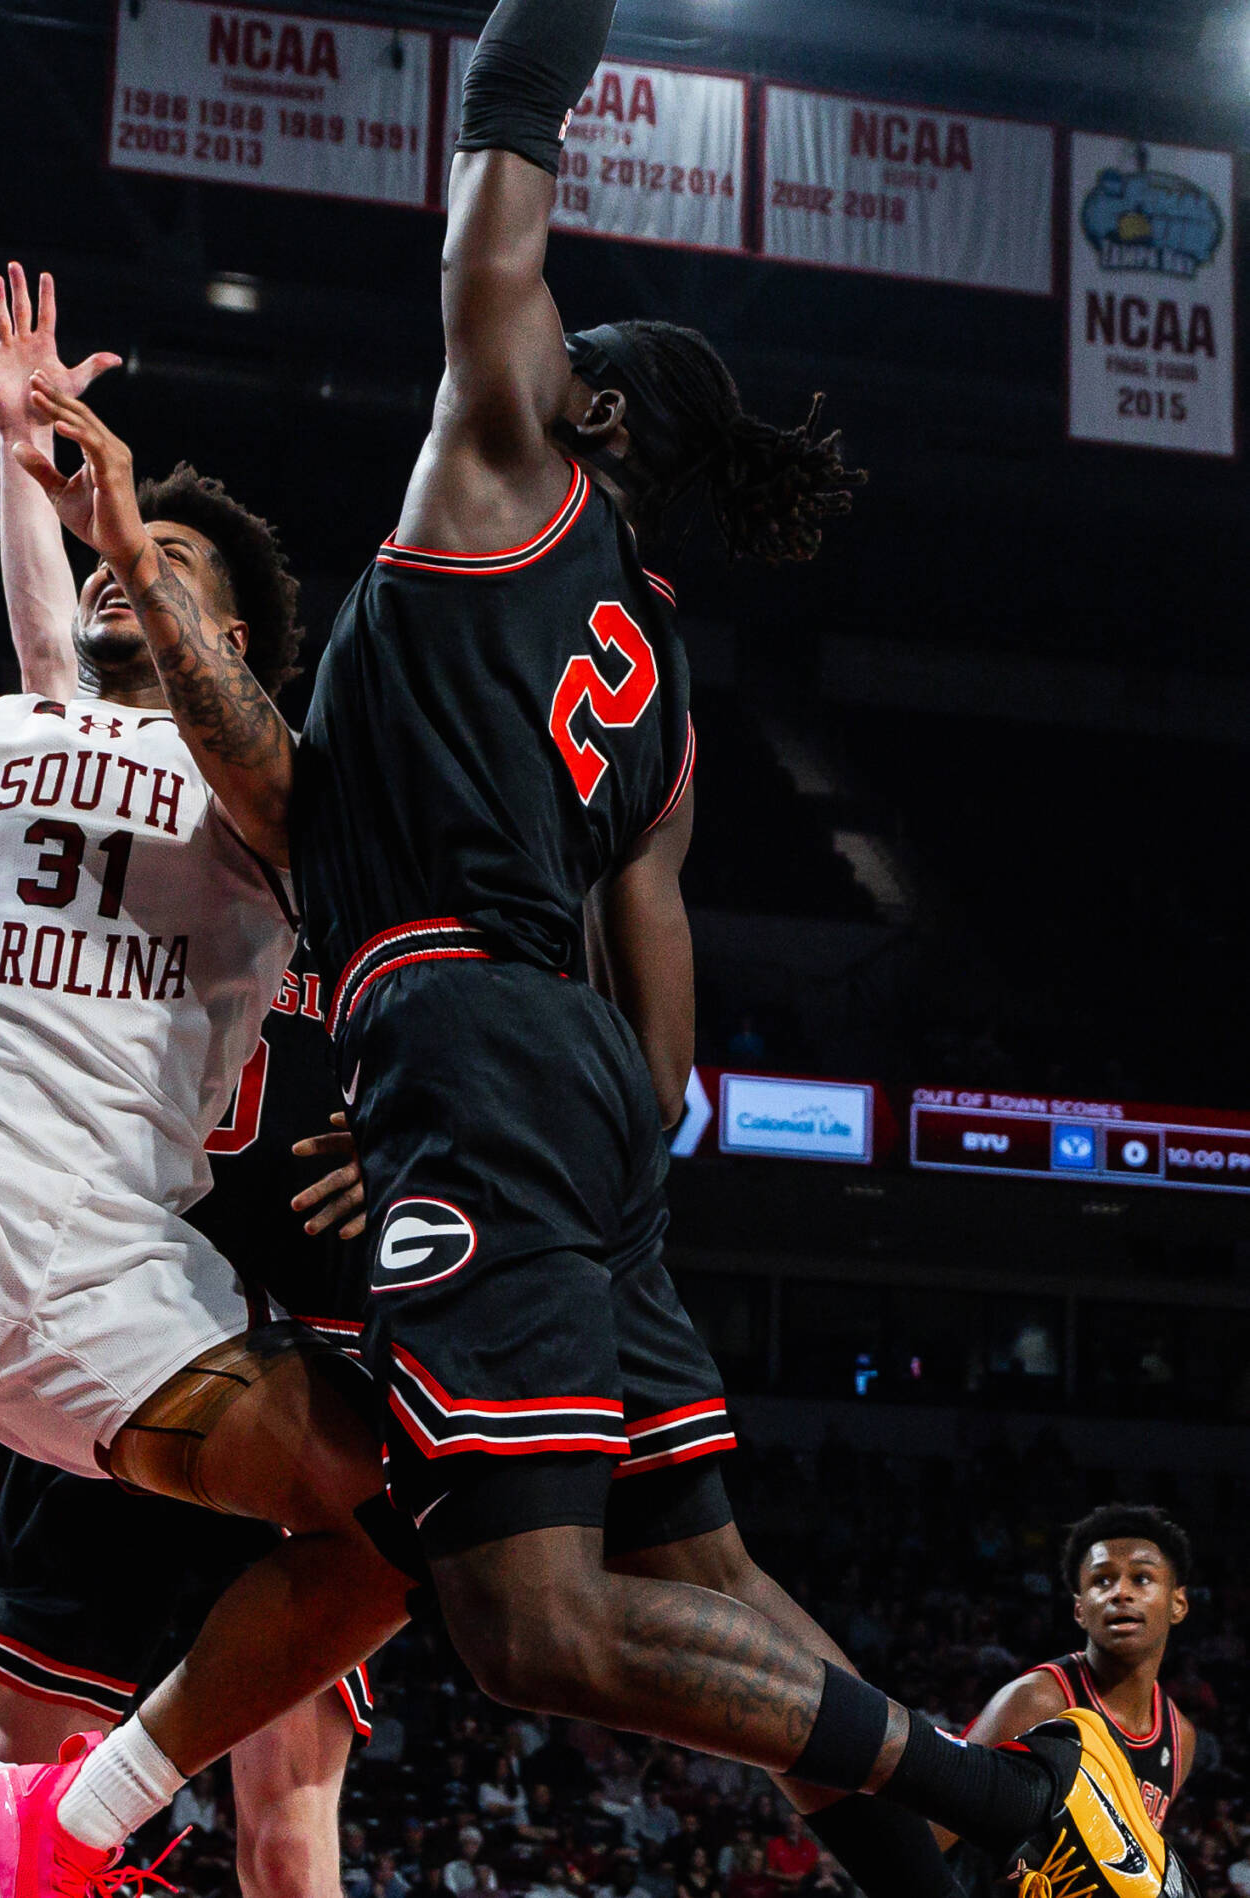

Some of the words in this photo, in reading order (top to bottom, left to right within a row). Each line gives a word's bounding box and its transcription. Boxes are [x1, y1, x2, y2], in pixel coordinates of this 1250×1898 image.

[208, 13, 340, 79] NCAA
[851, 109, 973, 173] NCAA
[601, 156, 665, 191] 2012
[669, 165, 734, 198] 2014
[1086, 289, 1217, 359] NCAA
[1118, 386, 1187, 422] 2015
[550, 600, 659, 806] 2
[16, 817, 135, 920] 31
[913, 1088, 953, 1106] OUT
[956, 1091, 985, 1109] OF
[990, 1094, 1048, 1114] TOWN
[1051, 1099, 1125, 1120] SCORES
[962, 1131, 1011, 1153] BYU
[1122, 1140, 1149, 1168] 0
